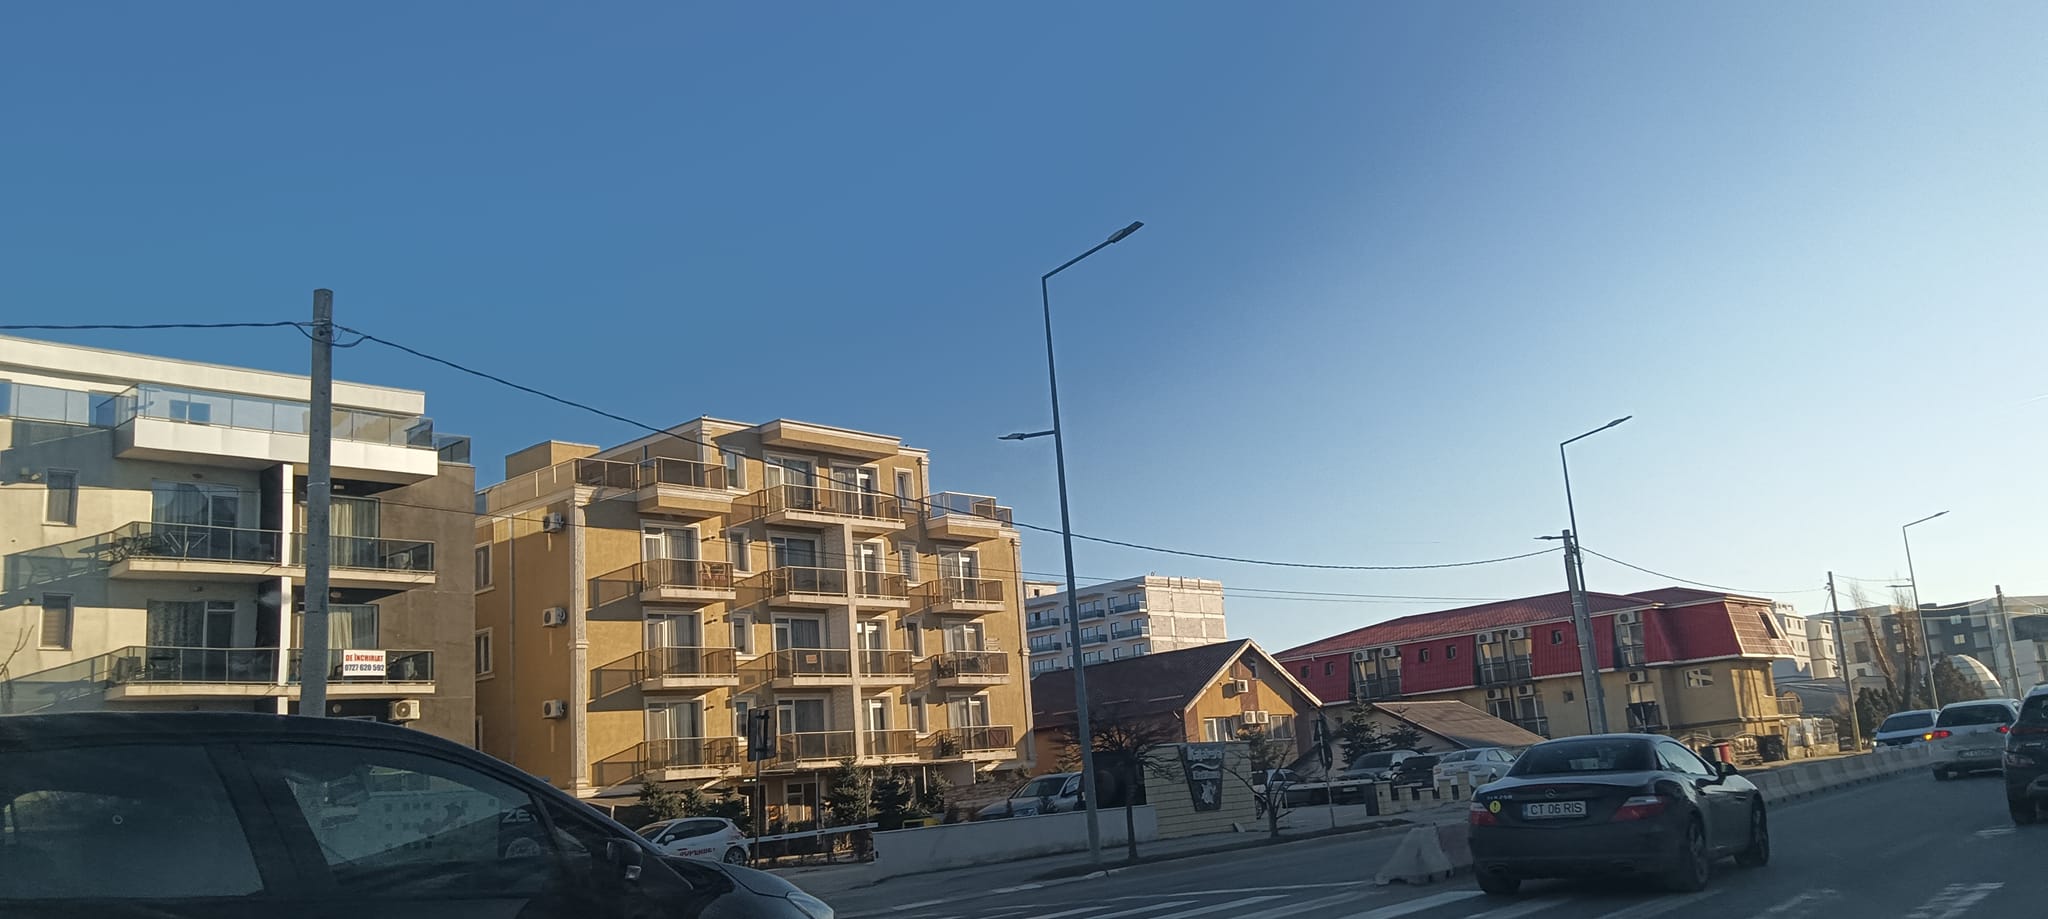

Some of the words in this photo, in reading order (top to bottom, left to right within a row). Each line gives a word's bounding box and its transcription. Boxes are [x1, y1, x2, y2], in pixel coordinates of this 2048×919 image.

[1530, 804, 1545, 815] CT
[1548, 803, 1562, 814] 06
[1564, 802, 1583, 813] RIS
